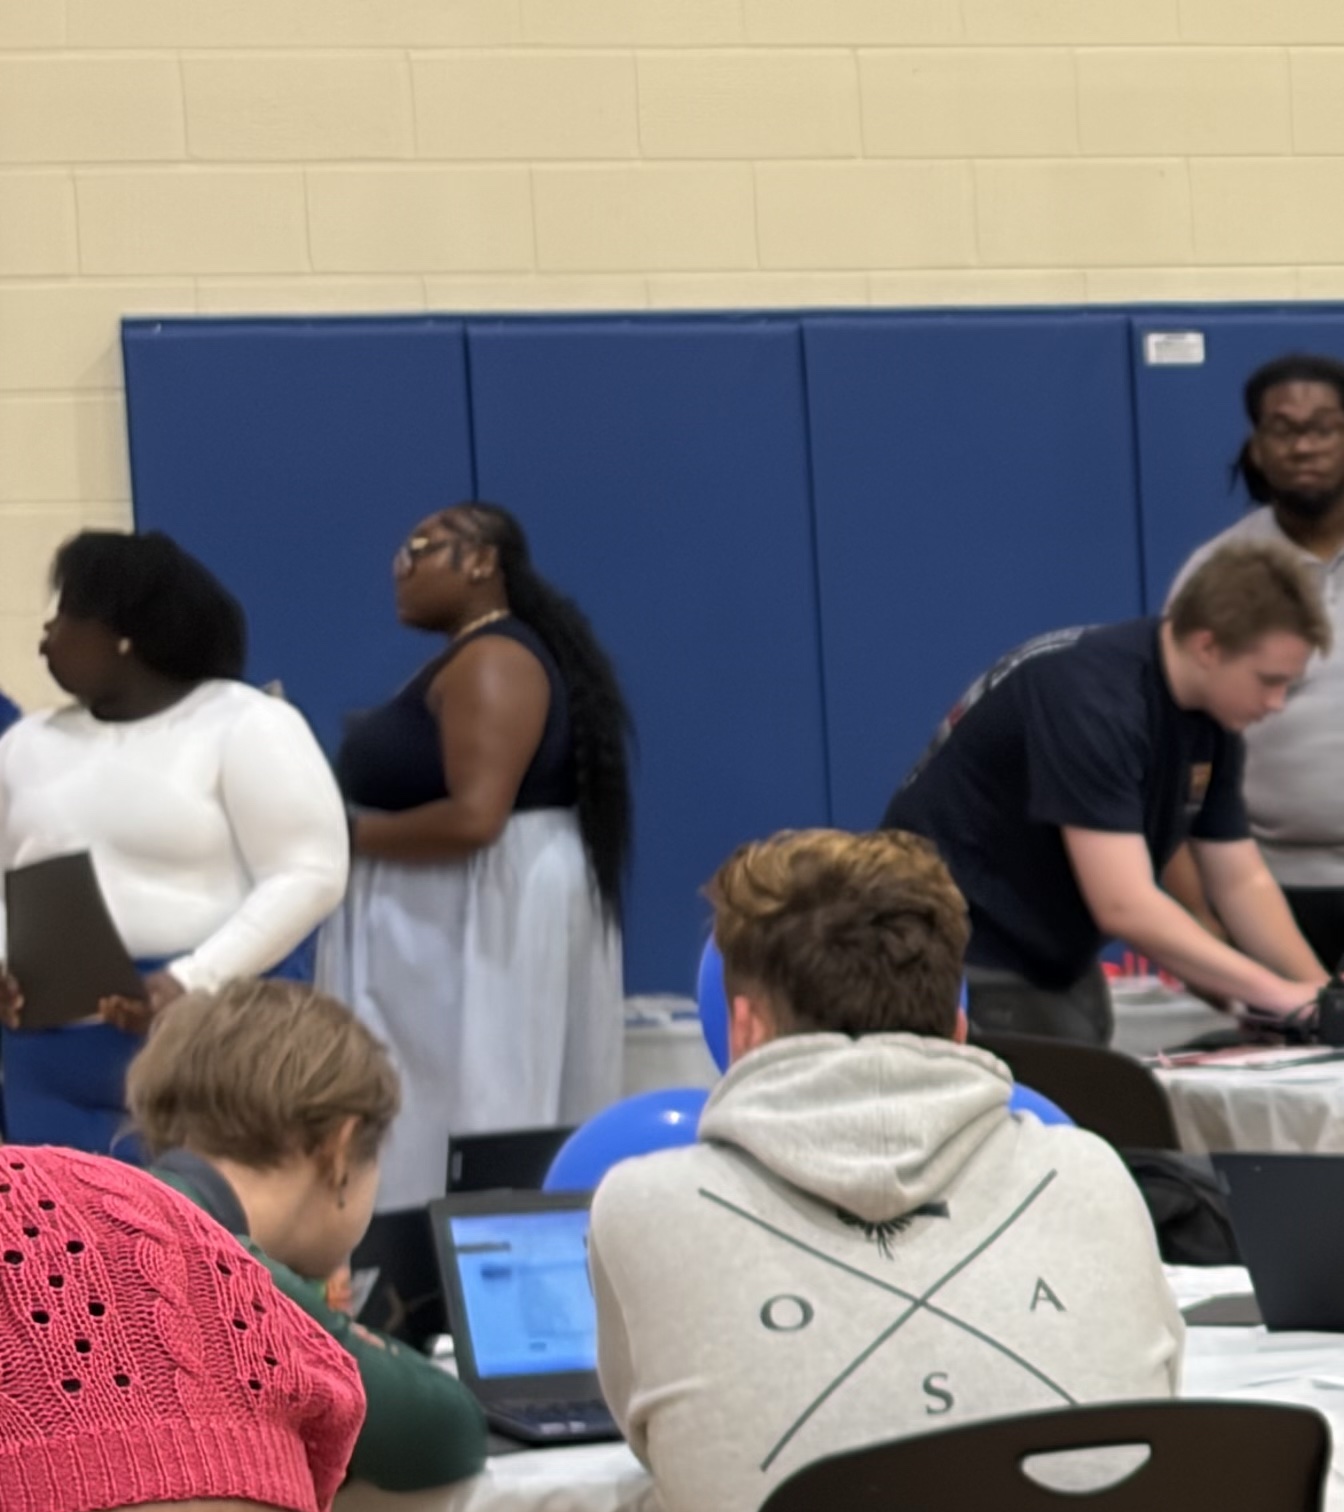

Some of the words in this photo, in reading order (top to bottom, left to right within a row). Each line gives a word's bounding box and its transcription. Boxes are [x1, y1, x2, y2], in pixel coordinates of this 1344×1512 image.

[759, 1292, 815, 1332] O
[1028, 1277, 1067, 1312] A
[921, 1371, 955, 1415] S
